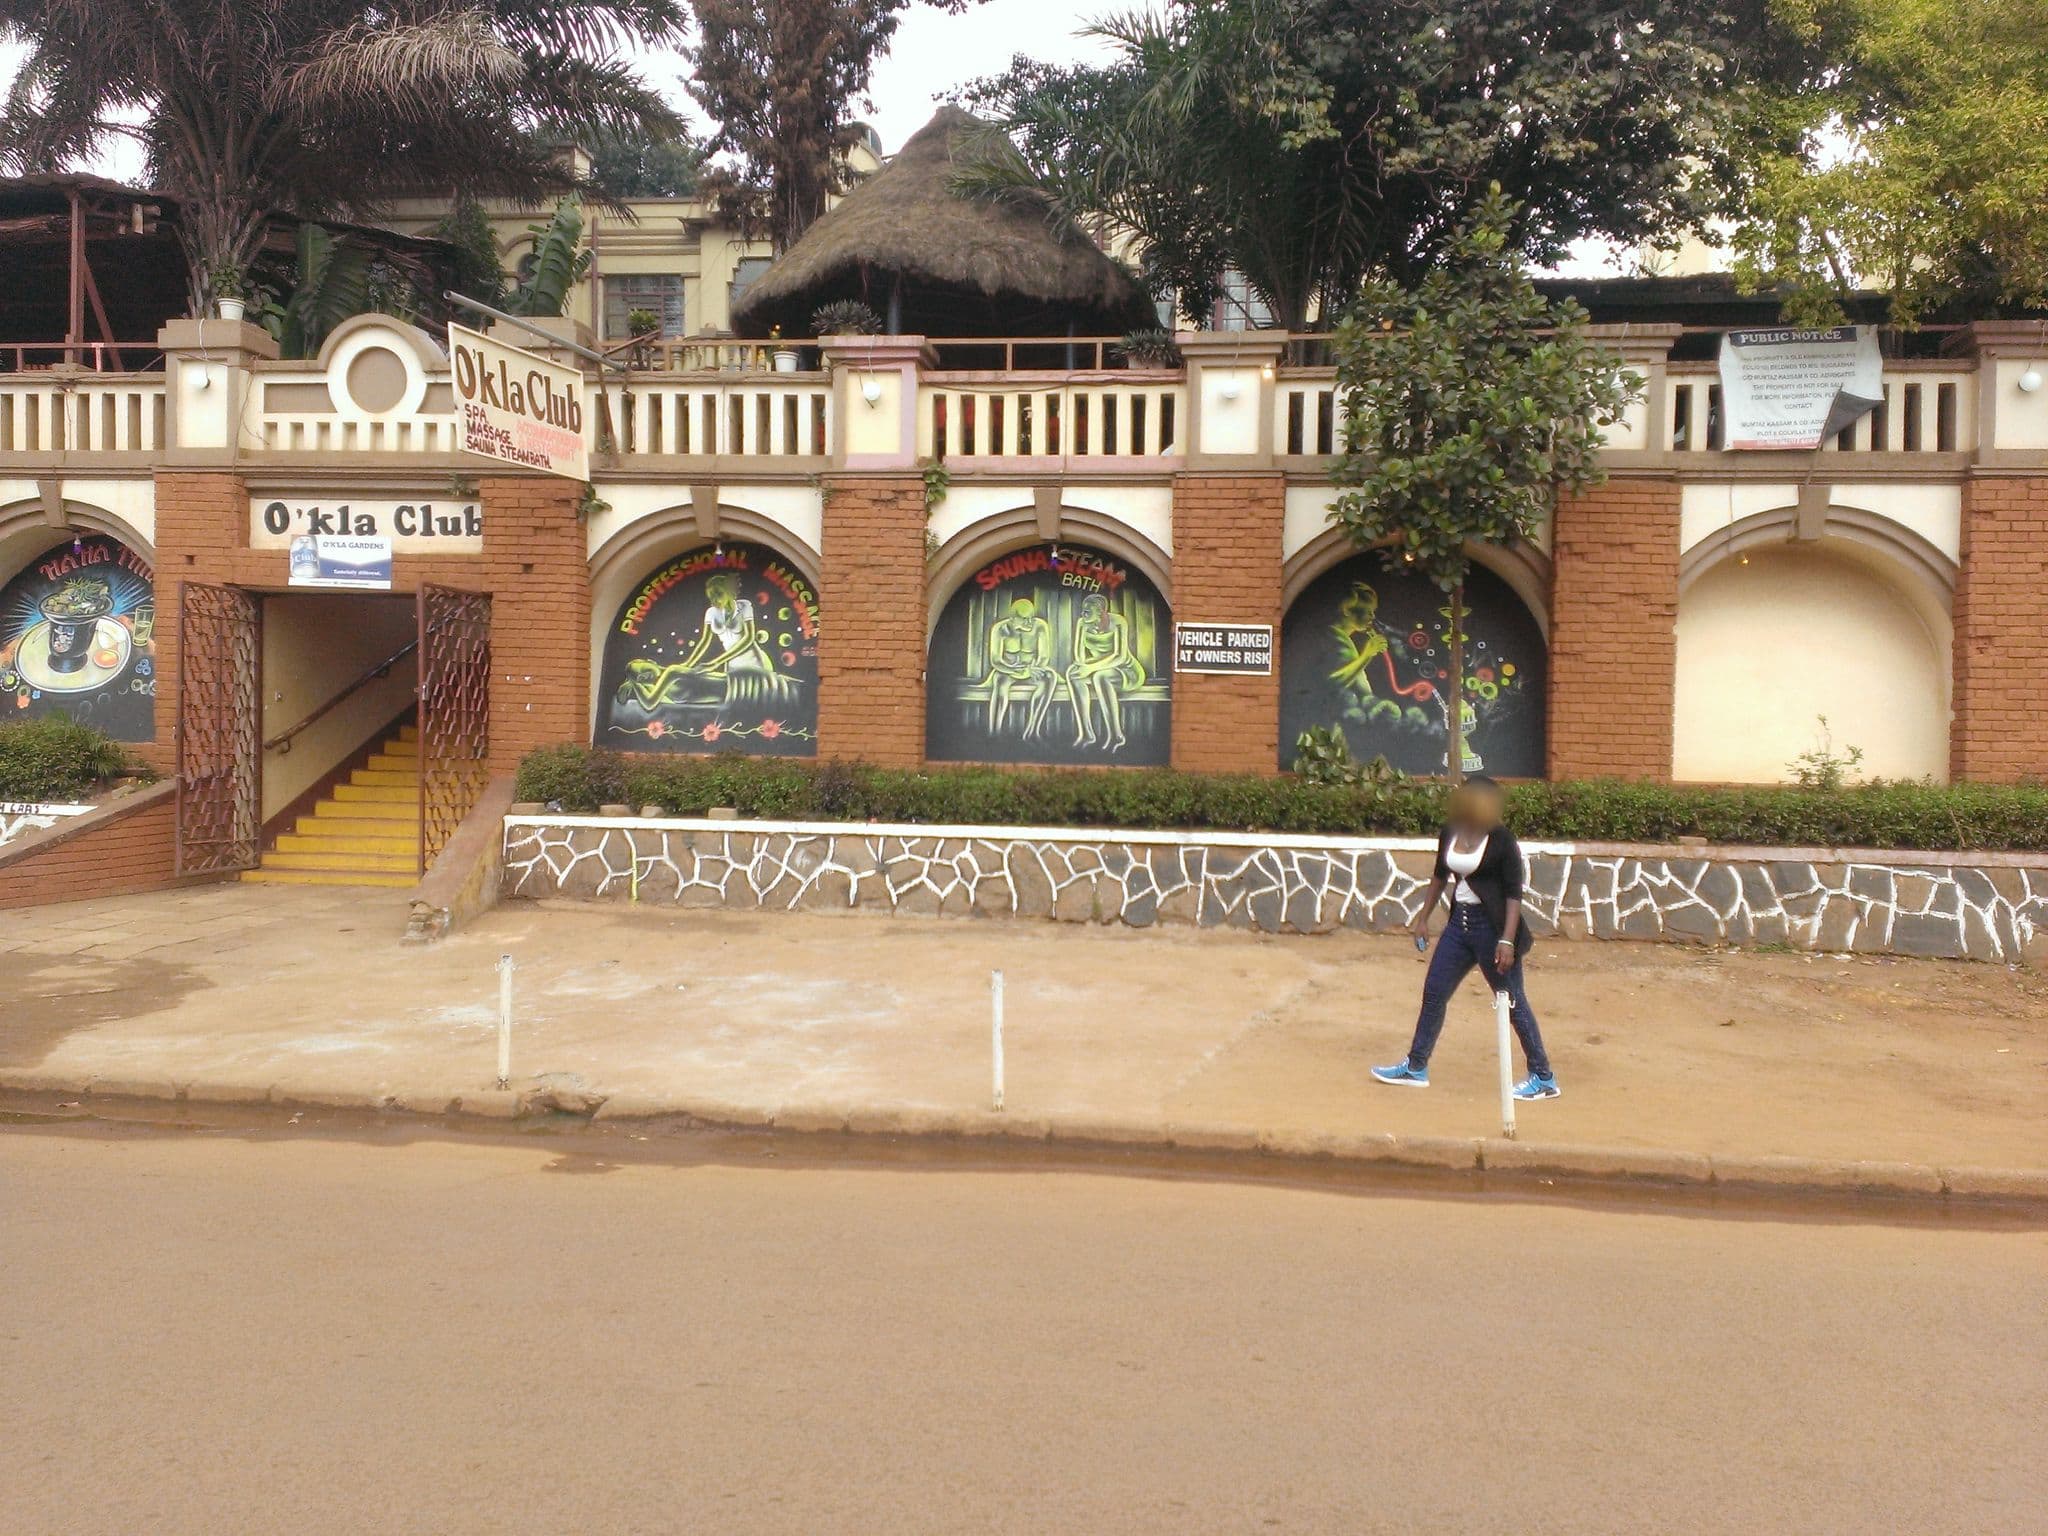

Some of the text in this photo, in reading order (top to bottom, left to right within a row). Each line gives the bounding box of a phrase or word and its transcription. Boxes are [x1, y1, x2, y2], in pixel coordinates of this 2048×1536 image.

[1741, 332, 1789, 344] PUBLIC
[455, 344, 582, 434] O'kla Club
[466, 435, 496, 456] SAUNA
[264, 502, 482, 537] O'kla Club
[348, 542, 385, 550] GARDENS
[975, 549, 1127, 591] SAUNA STEAM
[1062, 572, 1102, 593] BATH
[1178, 631, 1270, 648] VEHICLE PARKED
[1179, 650, 1270, 664] AT OWNERS RISK
